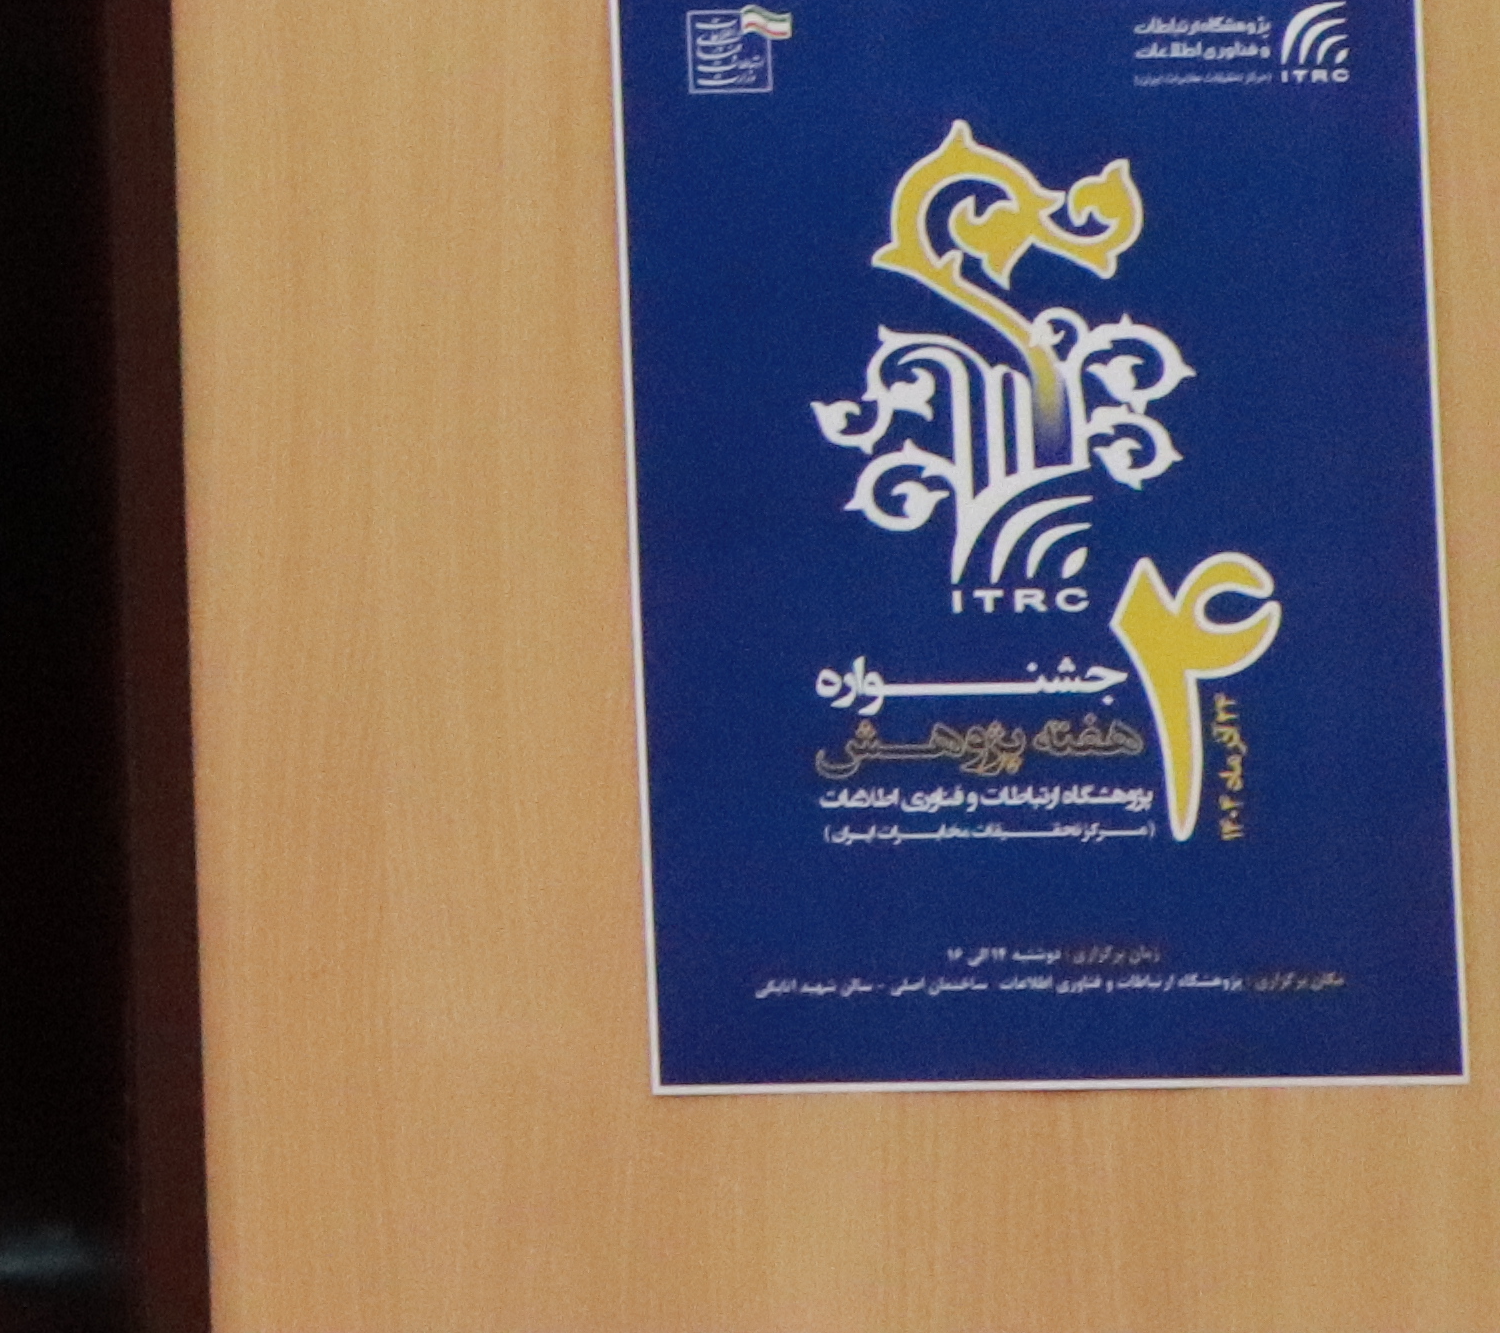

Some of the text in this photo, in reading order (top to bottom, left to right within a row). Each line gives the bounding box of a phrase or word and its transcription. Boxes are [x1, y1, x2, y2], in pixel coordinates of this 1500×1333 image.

[1281, 68, 1349, 83] ITRC
[950, 587, 1090, 613] ITRC
[815, 655, 1129, 716] جشنواره
[1110, 550, 1282, 842] ۴
[815, 711, 1144, 779] هفته پژوهش
[819, 784, 1154, 812] پژوهشگاه ارتباطات و فناوری اطلاعات
